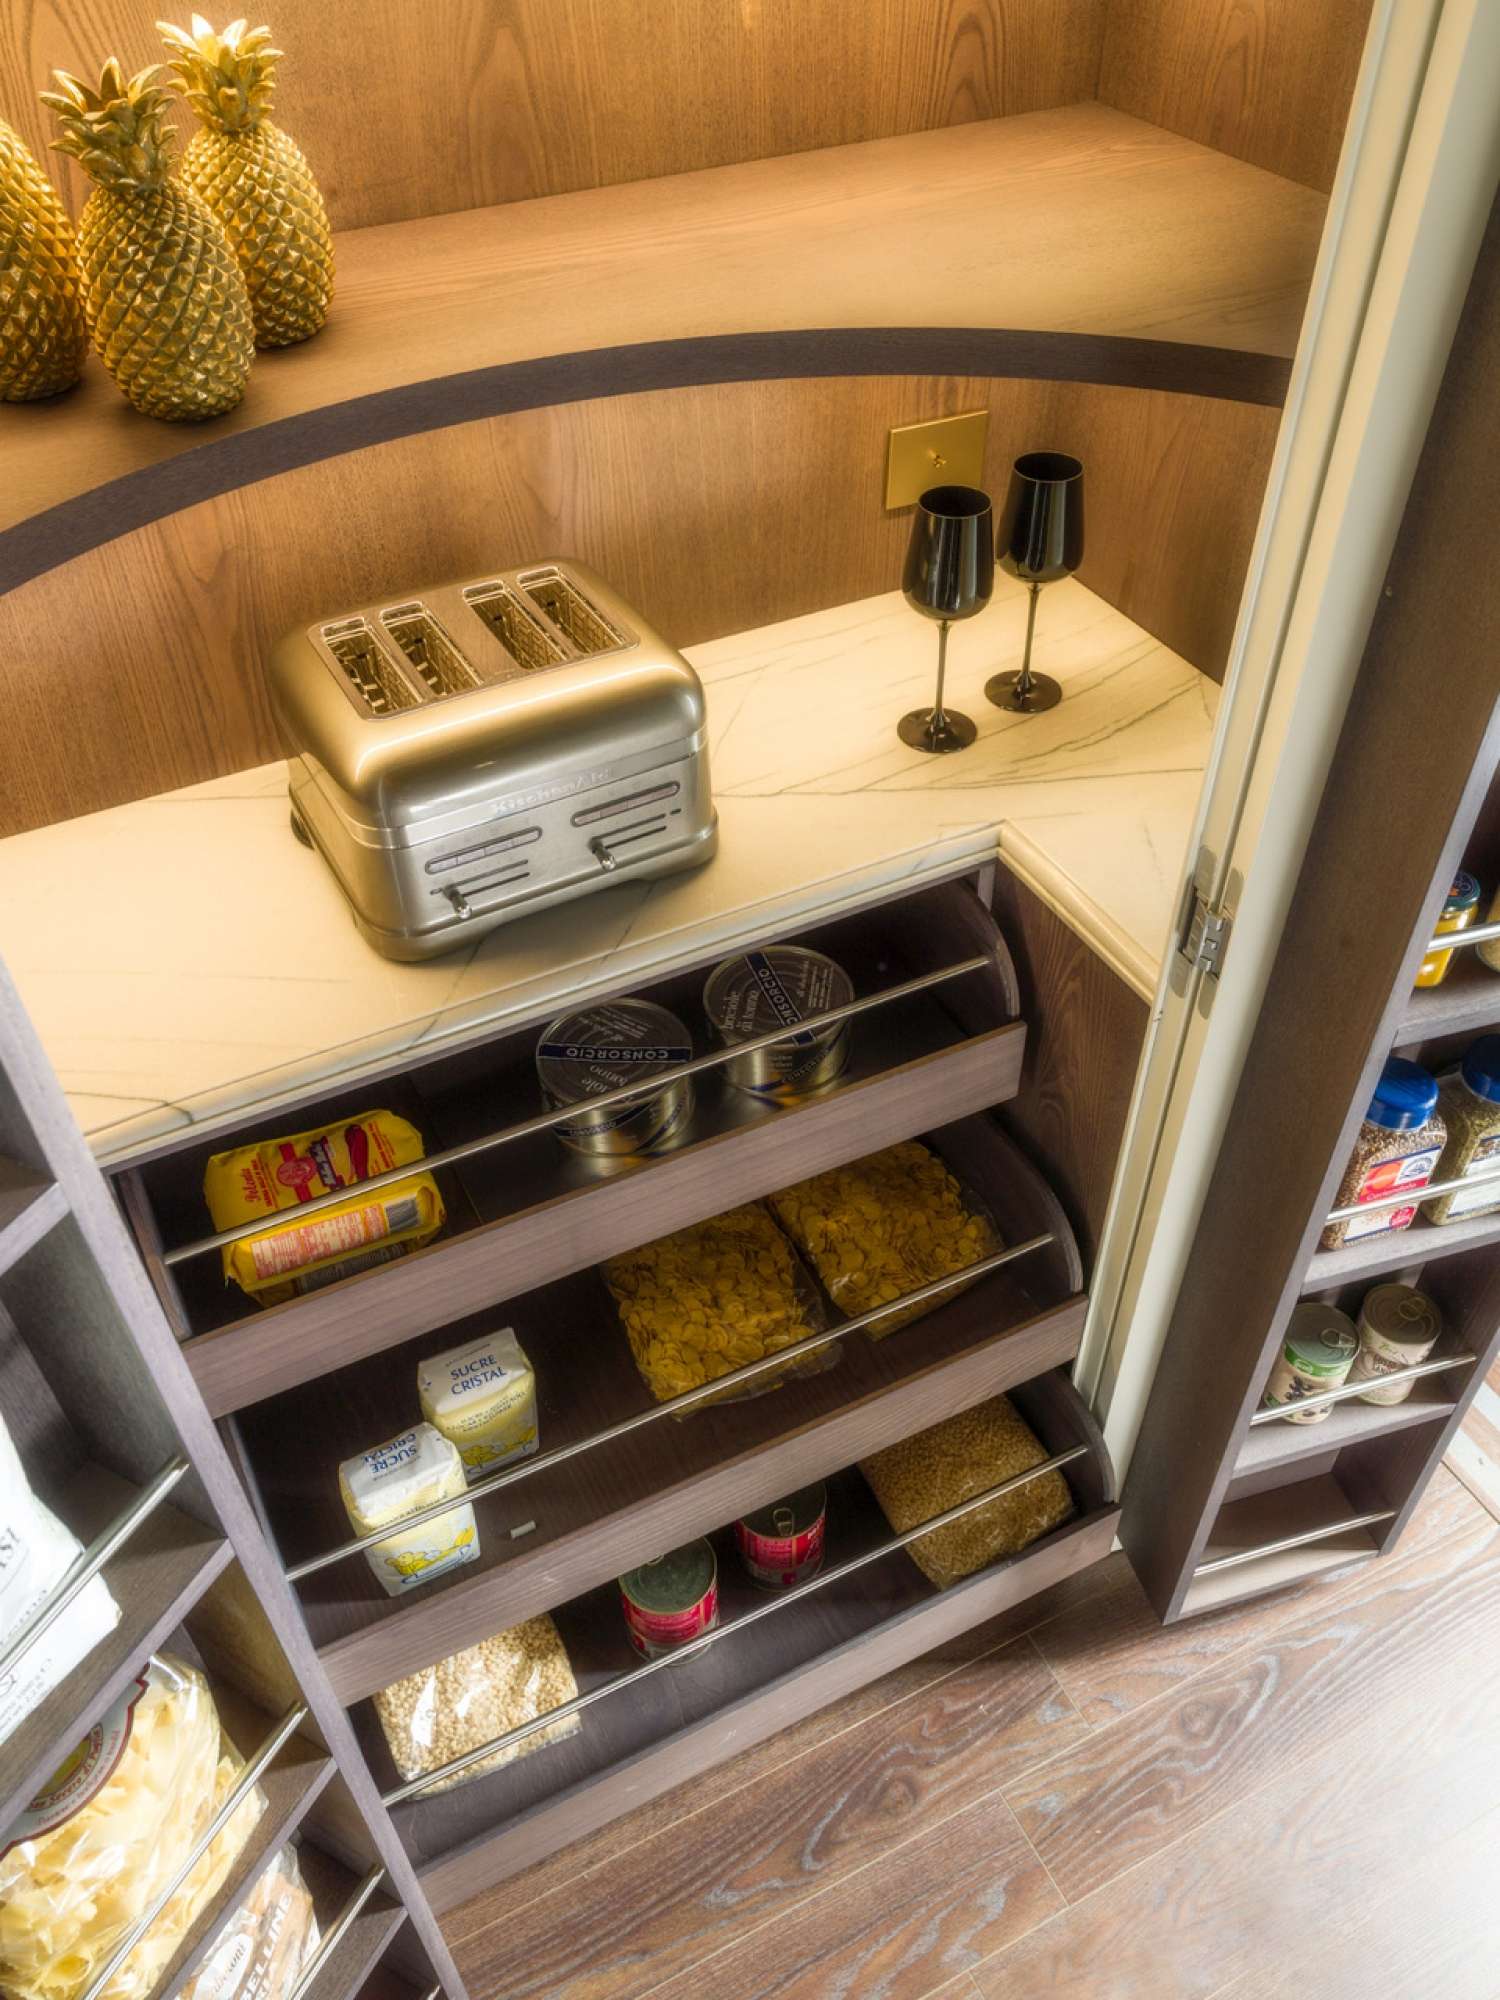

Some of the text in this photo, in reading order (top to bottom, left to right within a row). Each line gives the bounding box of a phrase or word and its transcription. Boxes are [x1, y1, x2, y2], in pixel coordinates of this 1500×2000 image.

[758, 967, 802, 1026] ONSORCIO
[566, 1046, 669, 1060] CONSORCIO
[450, 1354, 498, 1381] SUCRE
[450, 1368, 508, 1396] CRISTAL
[371, 1445, 418, 1474] SUCRE
